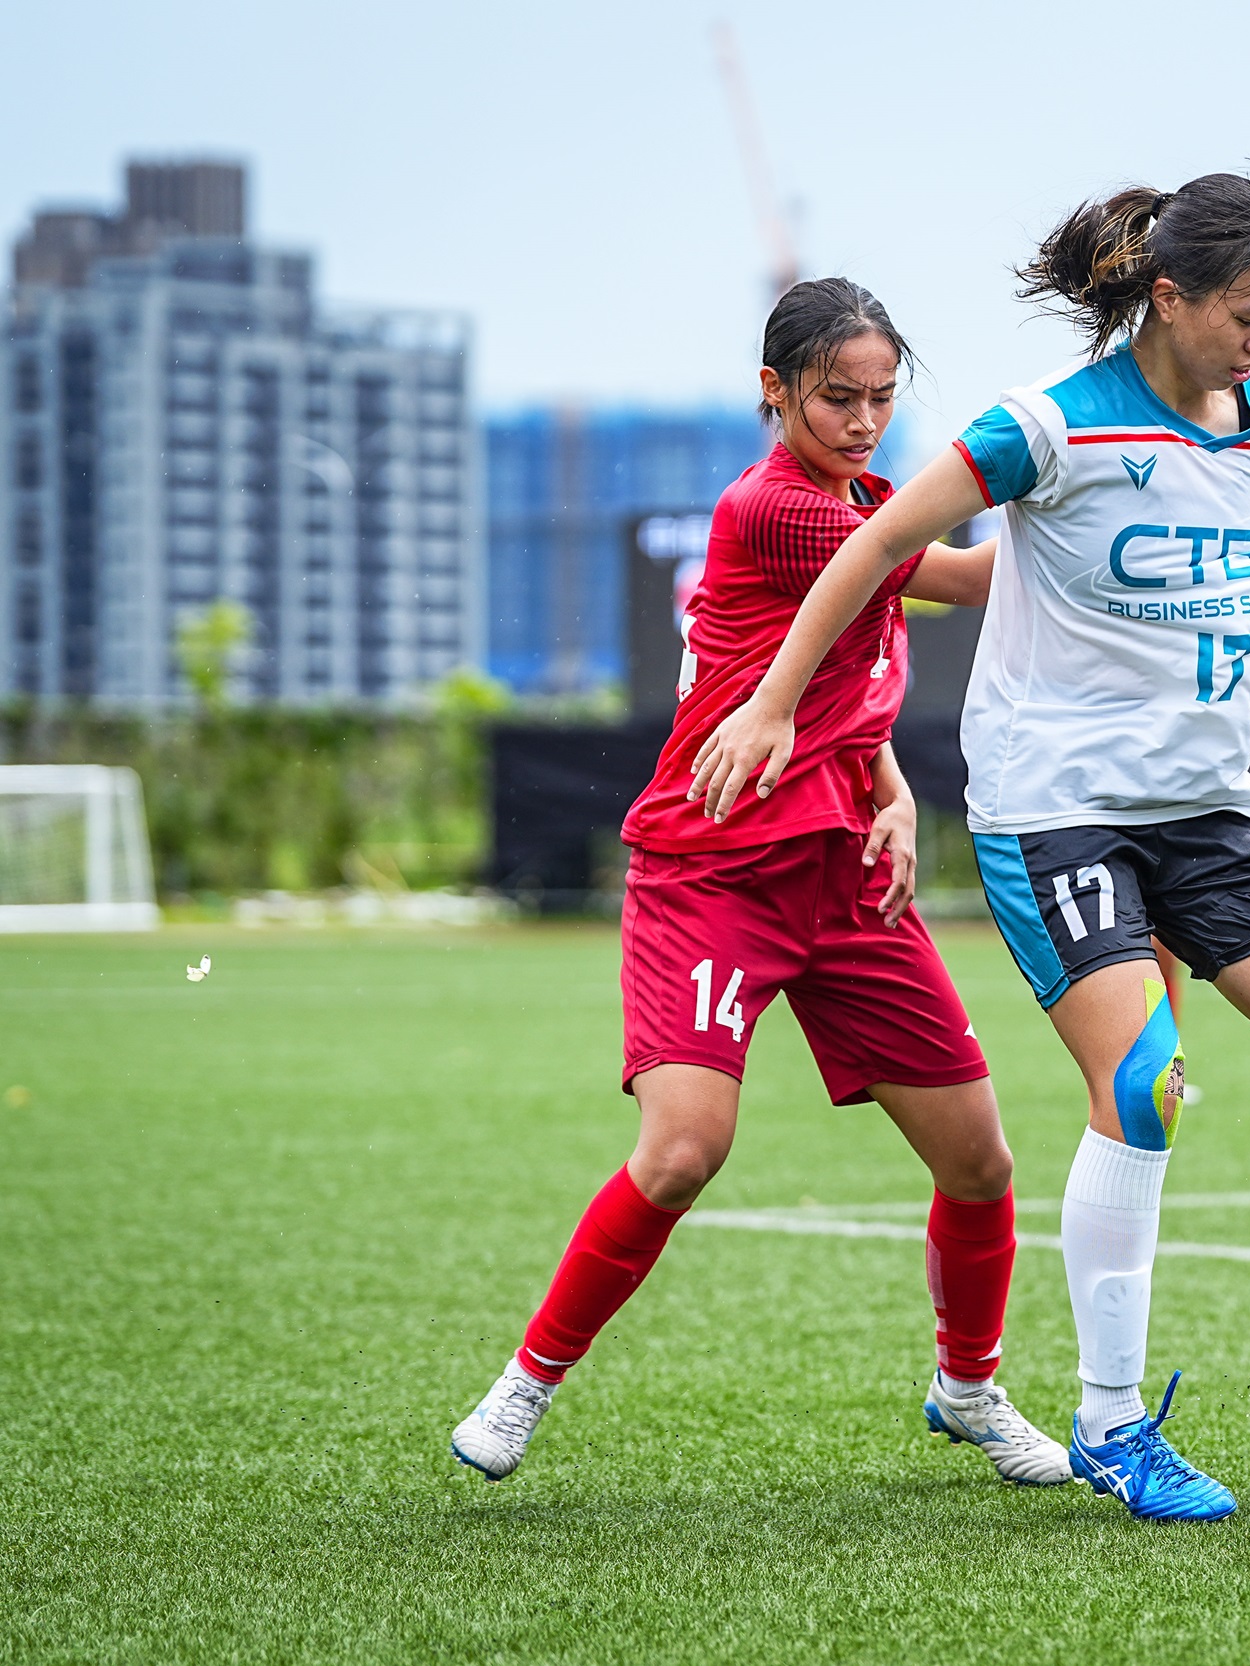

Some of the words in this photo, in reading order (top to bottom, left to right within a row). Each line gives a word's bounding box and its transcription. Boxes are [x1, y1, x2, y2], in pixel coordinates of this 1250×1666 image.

[1107, 596, 1236, 621] BUSINESS
[1052, 862, 1116, 943] 17
[690, 958, 746, 1043] 14
